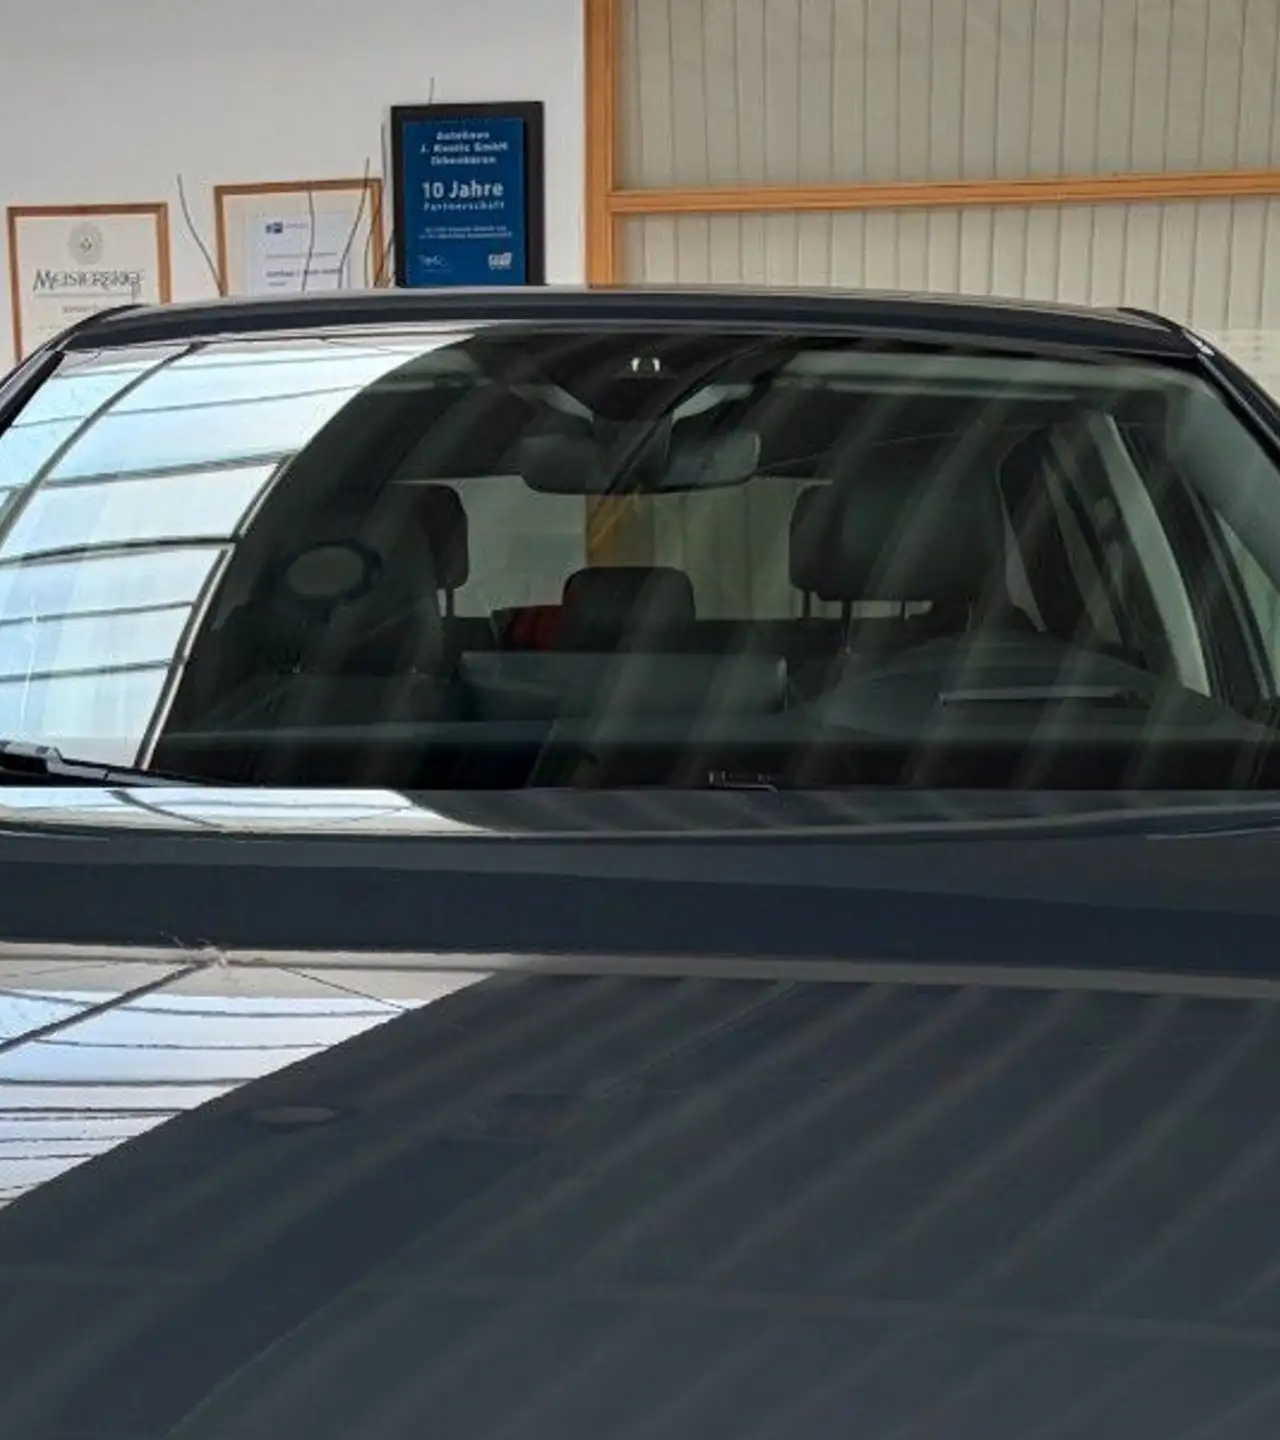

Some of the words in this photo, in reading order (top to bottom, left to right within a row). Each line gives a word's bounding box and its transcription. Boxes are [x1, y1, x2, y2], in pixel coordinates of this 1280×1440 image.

[422, 182, 445, 199] 10
[448, 179, 504, 198] Jahre
[423, 201, 505, 212] Partnerschaft
